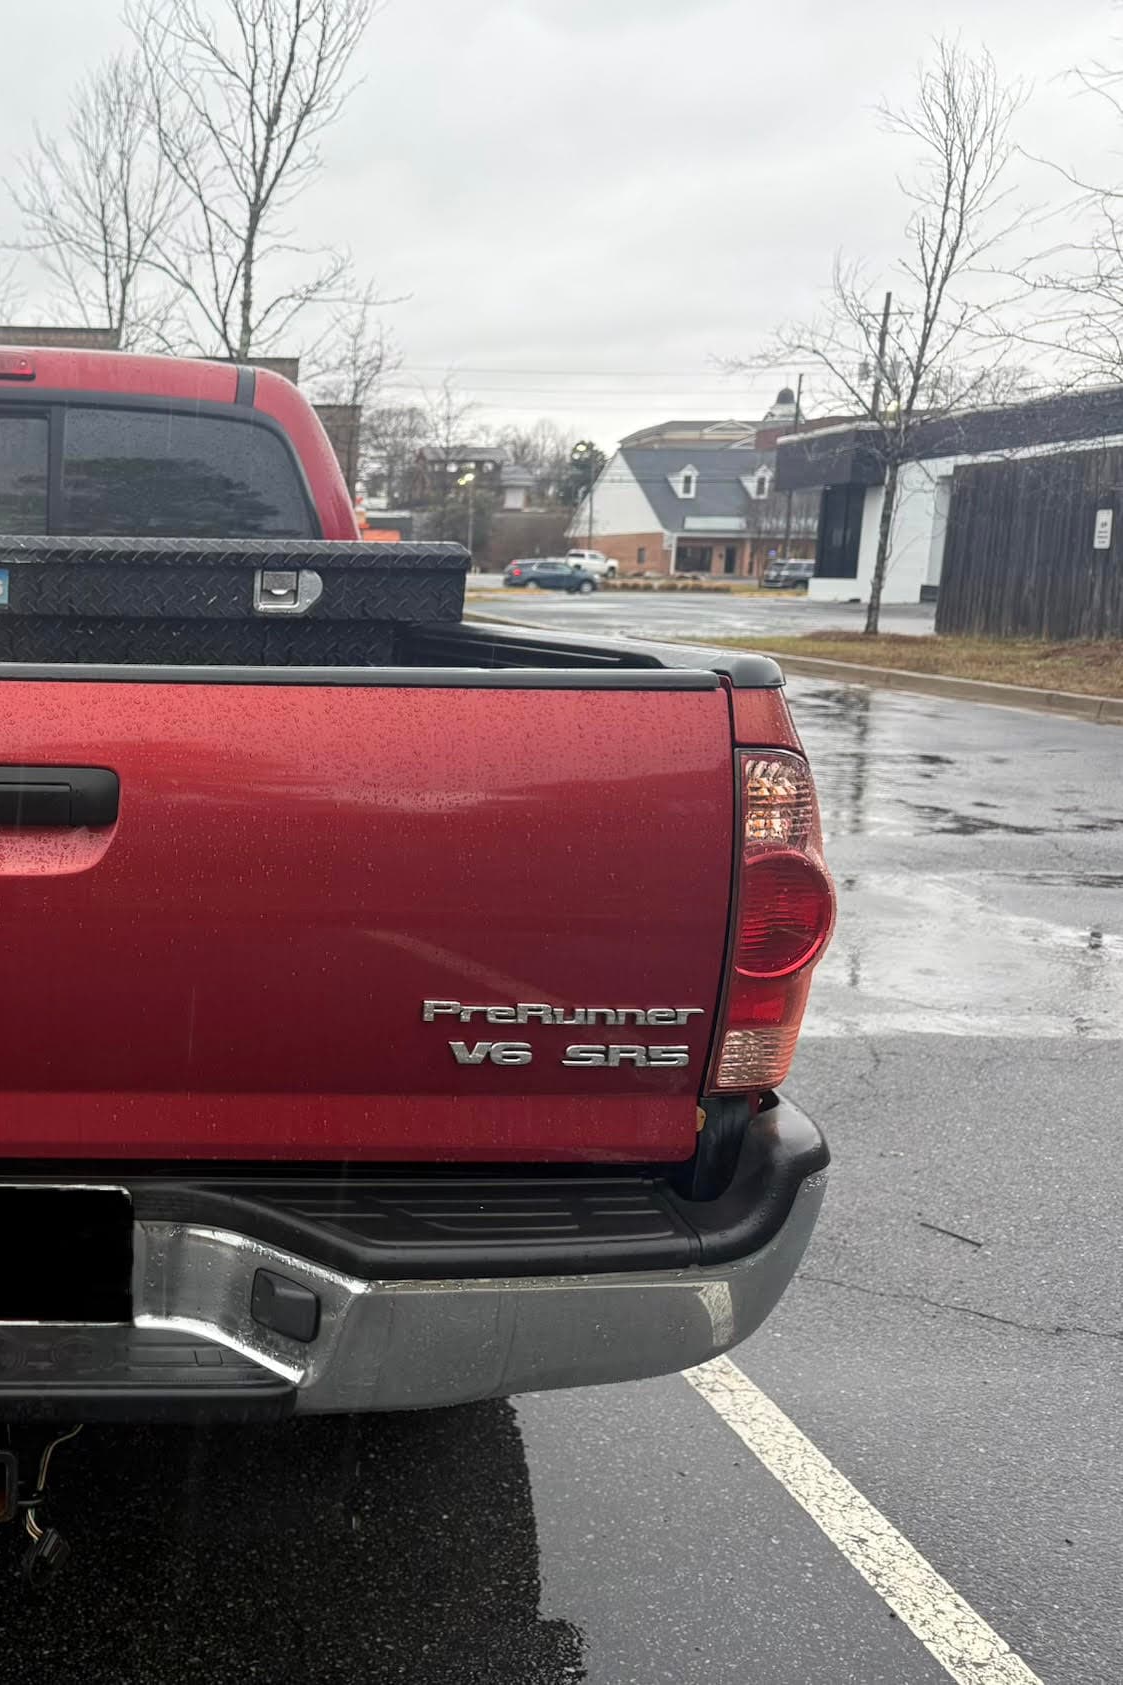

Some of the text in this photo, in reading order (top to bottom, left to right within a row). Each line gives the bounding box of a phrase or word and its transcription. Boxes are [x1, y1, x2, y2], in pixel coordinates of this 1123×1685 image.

[422, 1000, 705, 1026] PreRunner
[448, 1041, 689, 1067] V6 SR5
